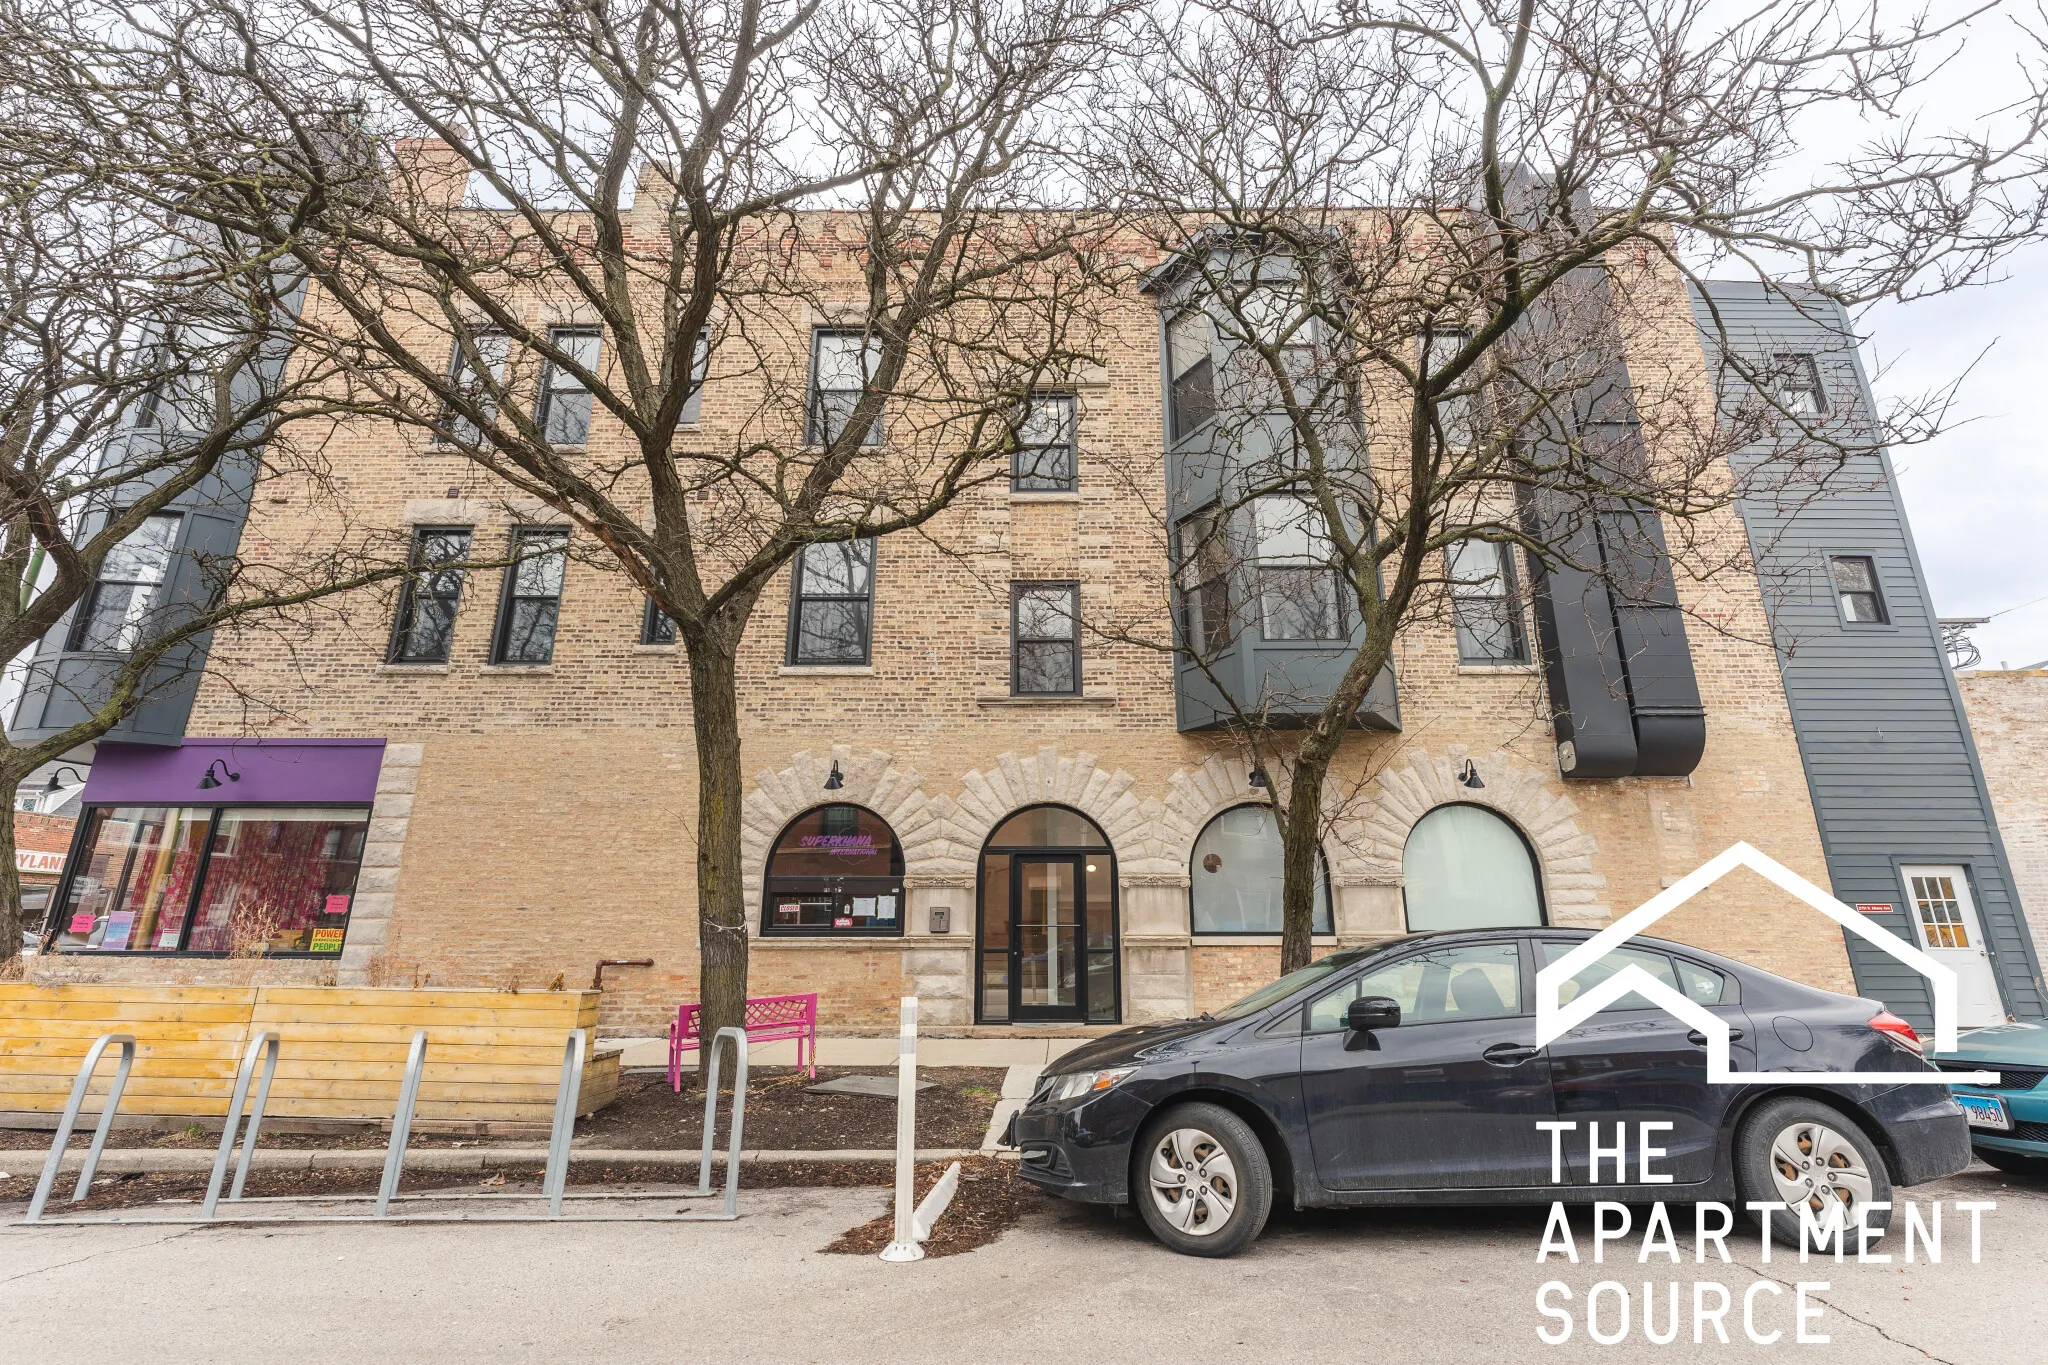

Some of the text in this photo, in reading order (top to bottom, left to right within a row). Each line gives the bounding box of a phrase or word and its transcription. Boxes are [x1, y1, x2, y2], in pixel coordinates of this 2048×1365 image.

[800, 835, 872, 847] SUPERKHANA
[315, 930, 344, 938] POWER
[1970, 1105, 2003, 1123] 98450
